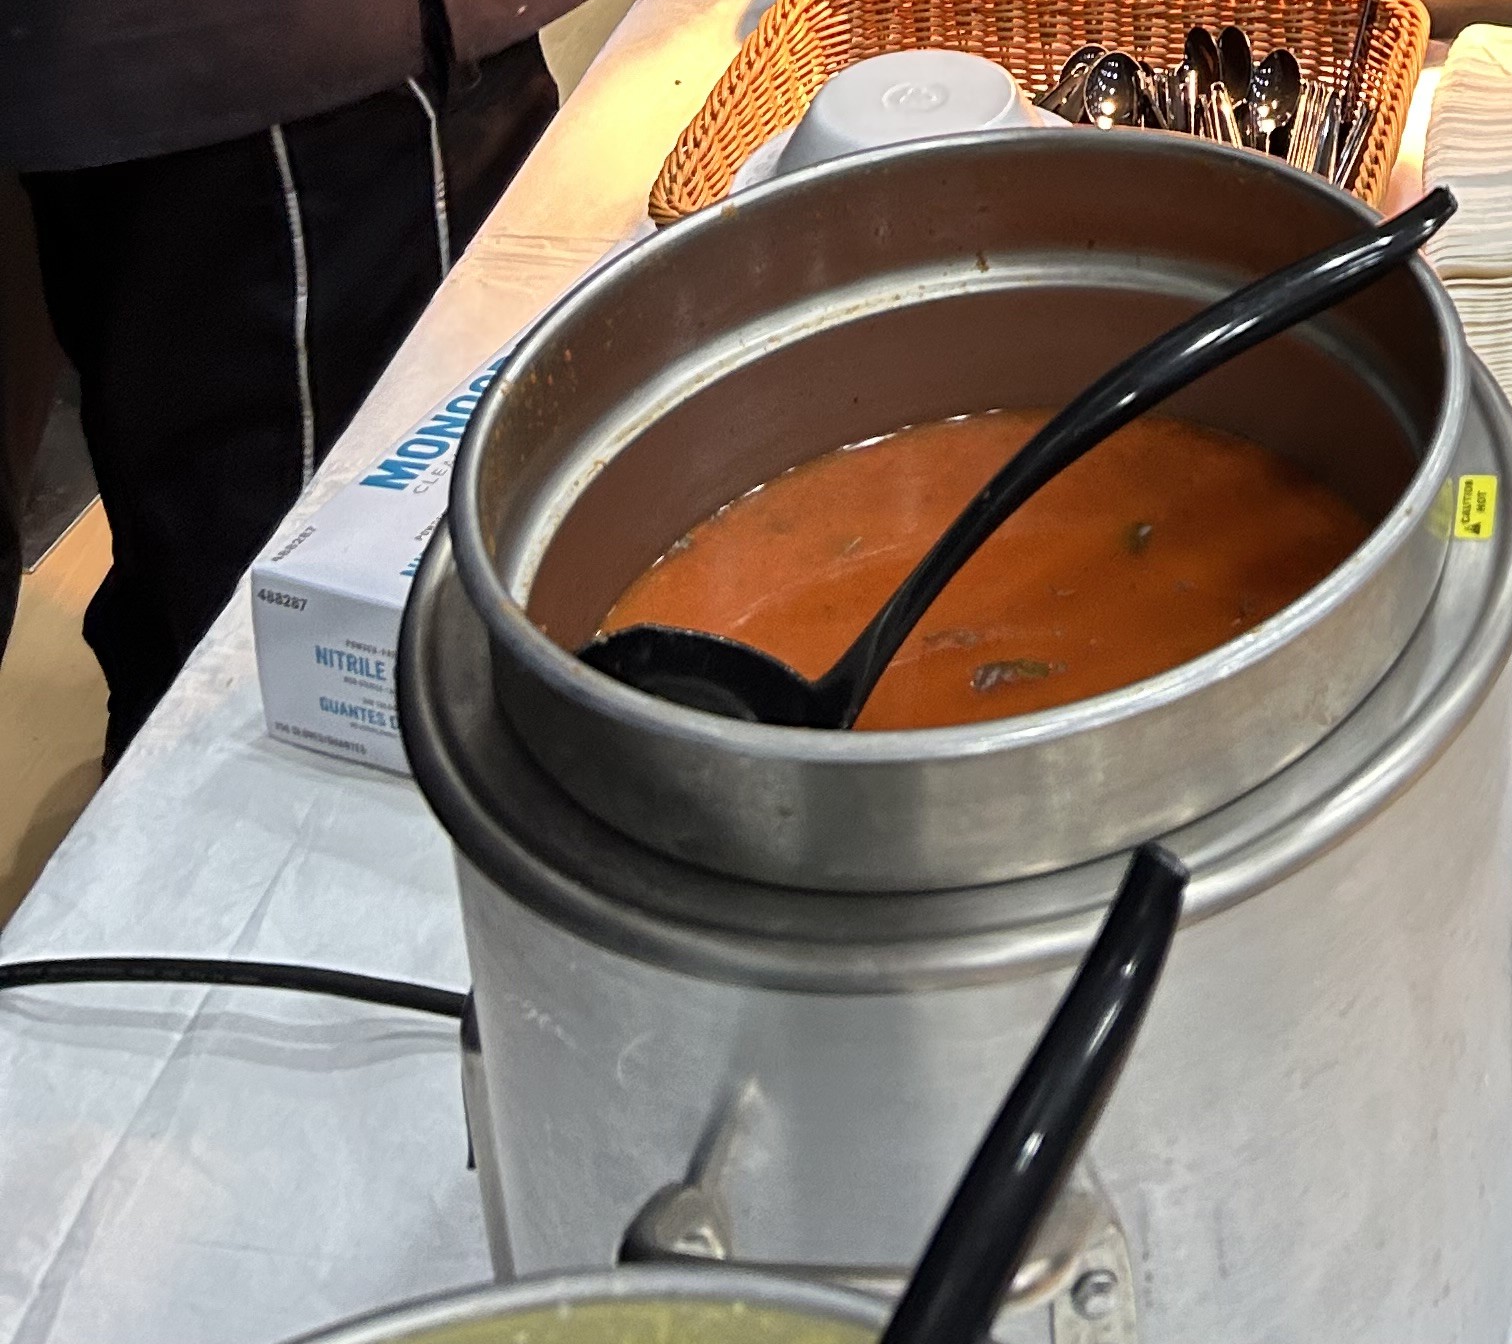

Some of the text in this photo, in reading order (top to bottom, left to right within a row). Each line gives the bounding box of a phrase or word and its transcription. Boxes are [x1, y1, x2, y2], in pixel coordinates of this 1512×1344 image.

[1477, 491, 1487, 512] HOT
[257, 588, 308, 612] 488287
[315, 644, 386, 681] NITRILE
[319, 696, 386, 727] GUANTES
